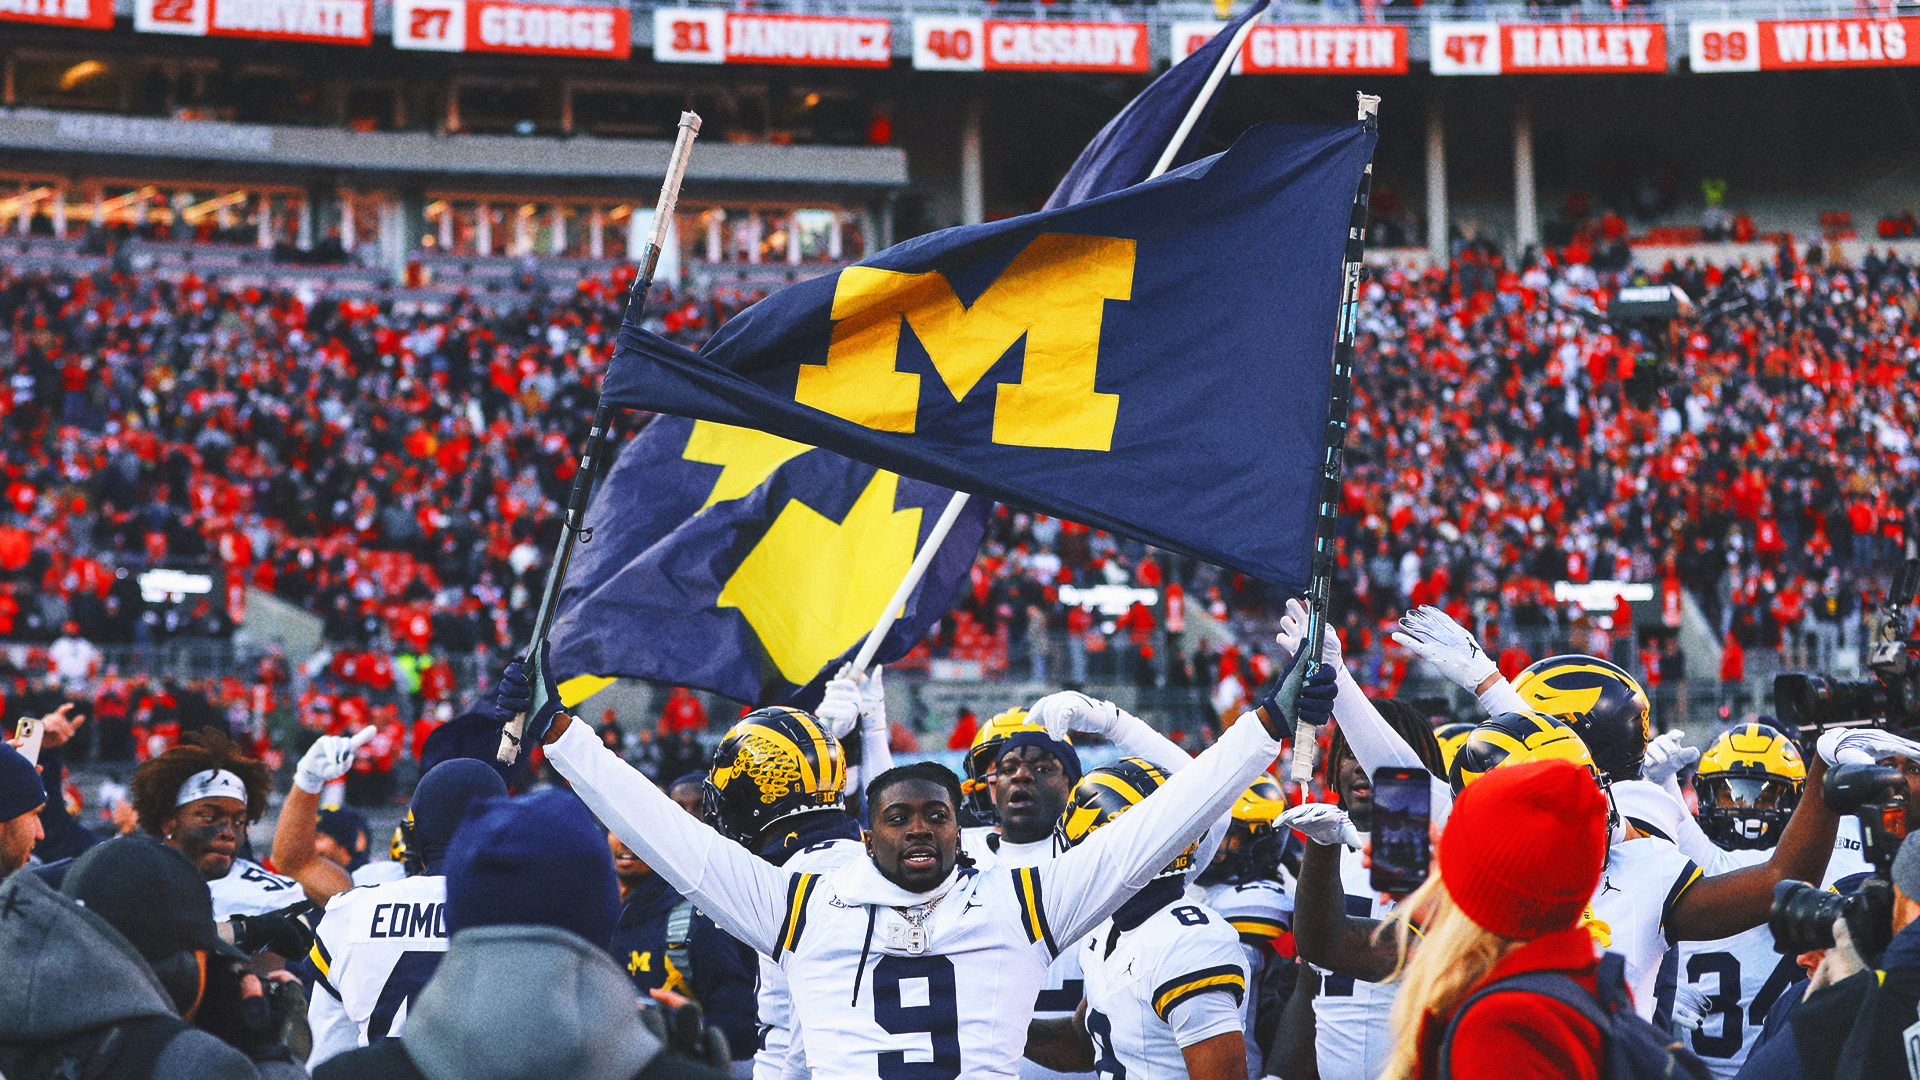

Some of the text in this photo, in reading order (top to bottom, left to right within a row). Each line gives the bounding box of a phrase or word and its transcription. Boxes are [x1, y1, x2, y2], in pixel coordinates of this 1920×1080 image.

[410, 6, 615, 49] 27 GEORGE
[730, 19, 888, 60] JANOWICZ
[928, 26, 1138, 65] 40 CASSADY
[1445, 28, 1650, 66] 47 HARLEY
[1703, 22, 1907, 62] 99 WILLIS
[1252, 29, 1395, 67] GRIFFIN
[795, 233, 1136, 451] M
[1171, 905, 1210, 926] 8
[627, 950, 652, 973] M
[872, 955, 962, 1080] 9
